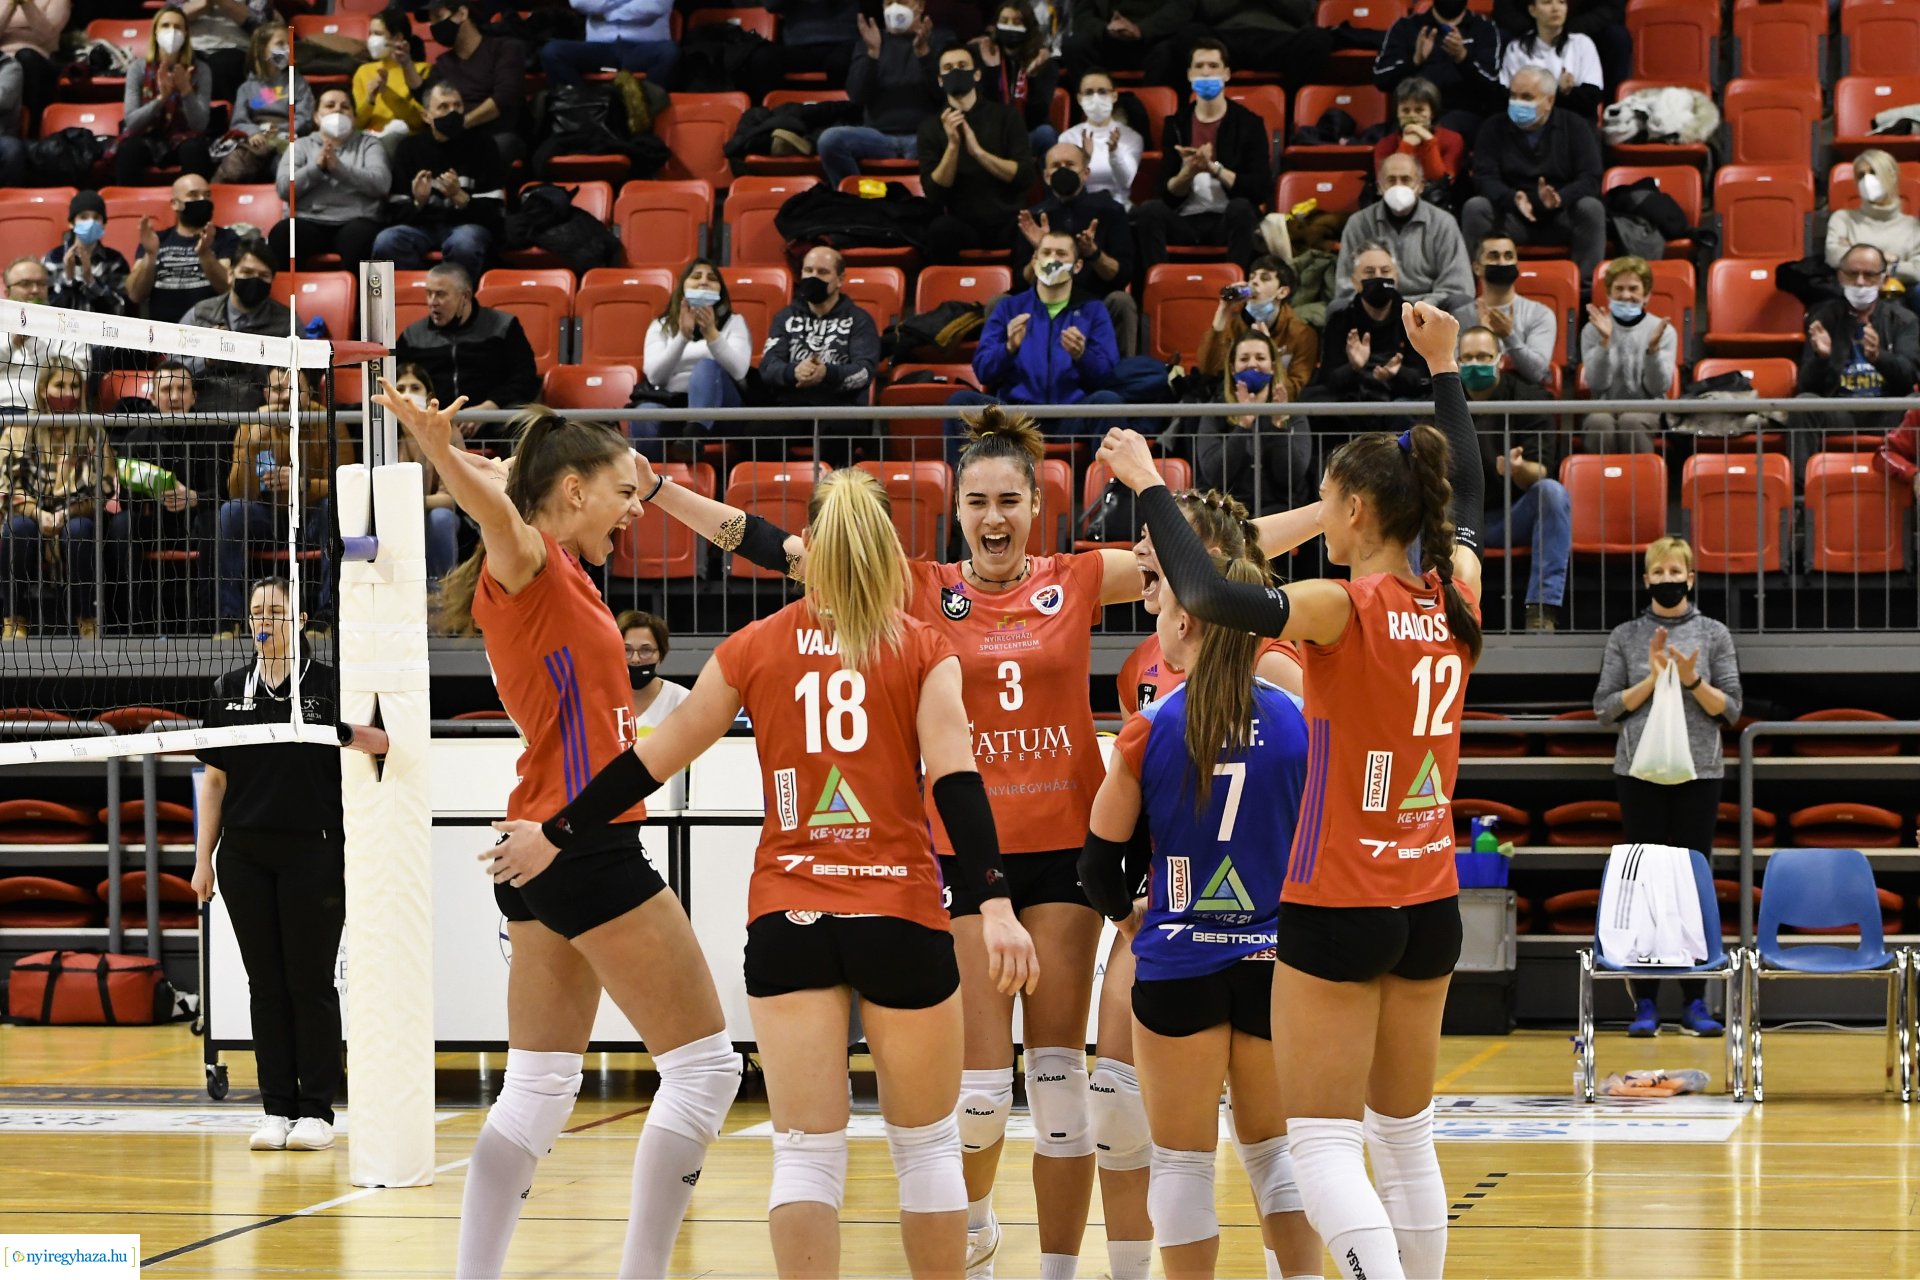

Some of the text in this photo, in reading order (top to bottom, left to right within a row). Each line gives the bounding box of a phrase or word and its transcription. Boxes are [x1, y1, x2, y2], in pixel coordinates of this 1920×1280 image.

[1387, 611, 1452, 642] RADOS
[796, 629, 842, 656] VAJ
[979, 640, 1040, 651] SPORTCENTRUM
[997, 660, 1024, 711] 3
[1411, 654, 1462, 737] 12
[794, 669, 868, 754] 18
[985, 747, 1073, 764] OPERTY
[1371, 754, 1385, 808] STRABAG
[781, 772, 794, 827] STRABAG
[1212, 762, 1247, 842] 7
[1397, 809, 1435, 824] KE-VIZ
[809, 827, 871, 841] KE-VIZ 21
[812, 864, 908, 877] BESTRONG
[1174, 859, 1184, 910] STRABAG
[1237, 914, 1252, 924] 21
[1192, 931, 1278, 944] BESTRON
[1346, 1247, 1367, 1280] IKASA
